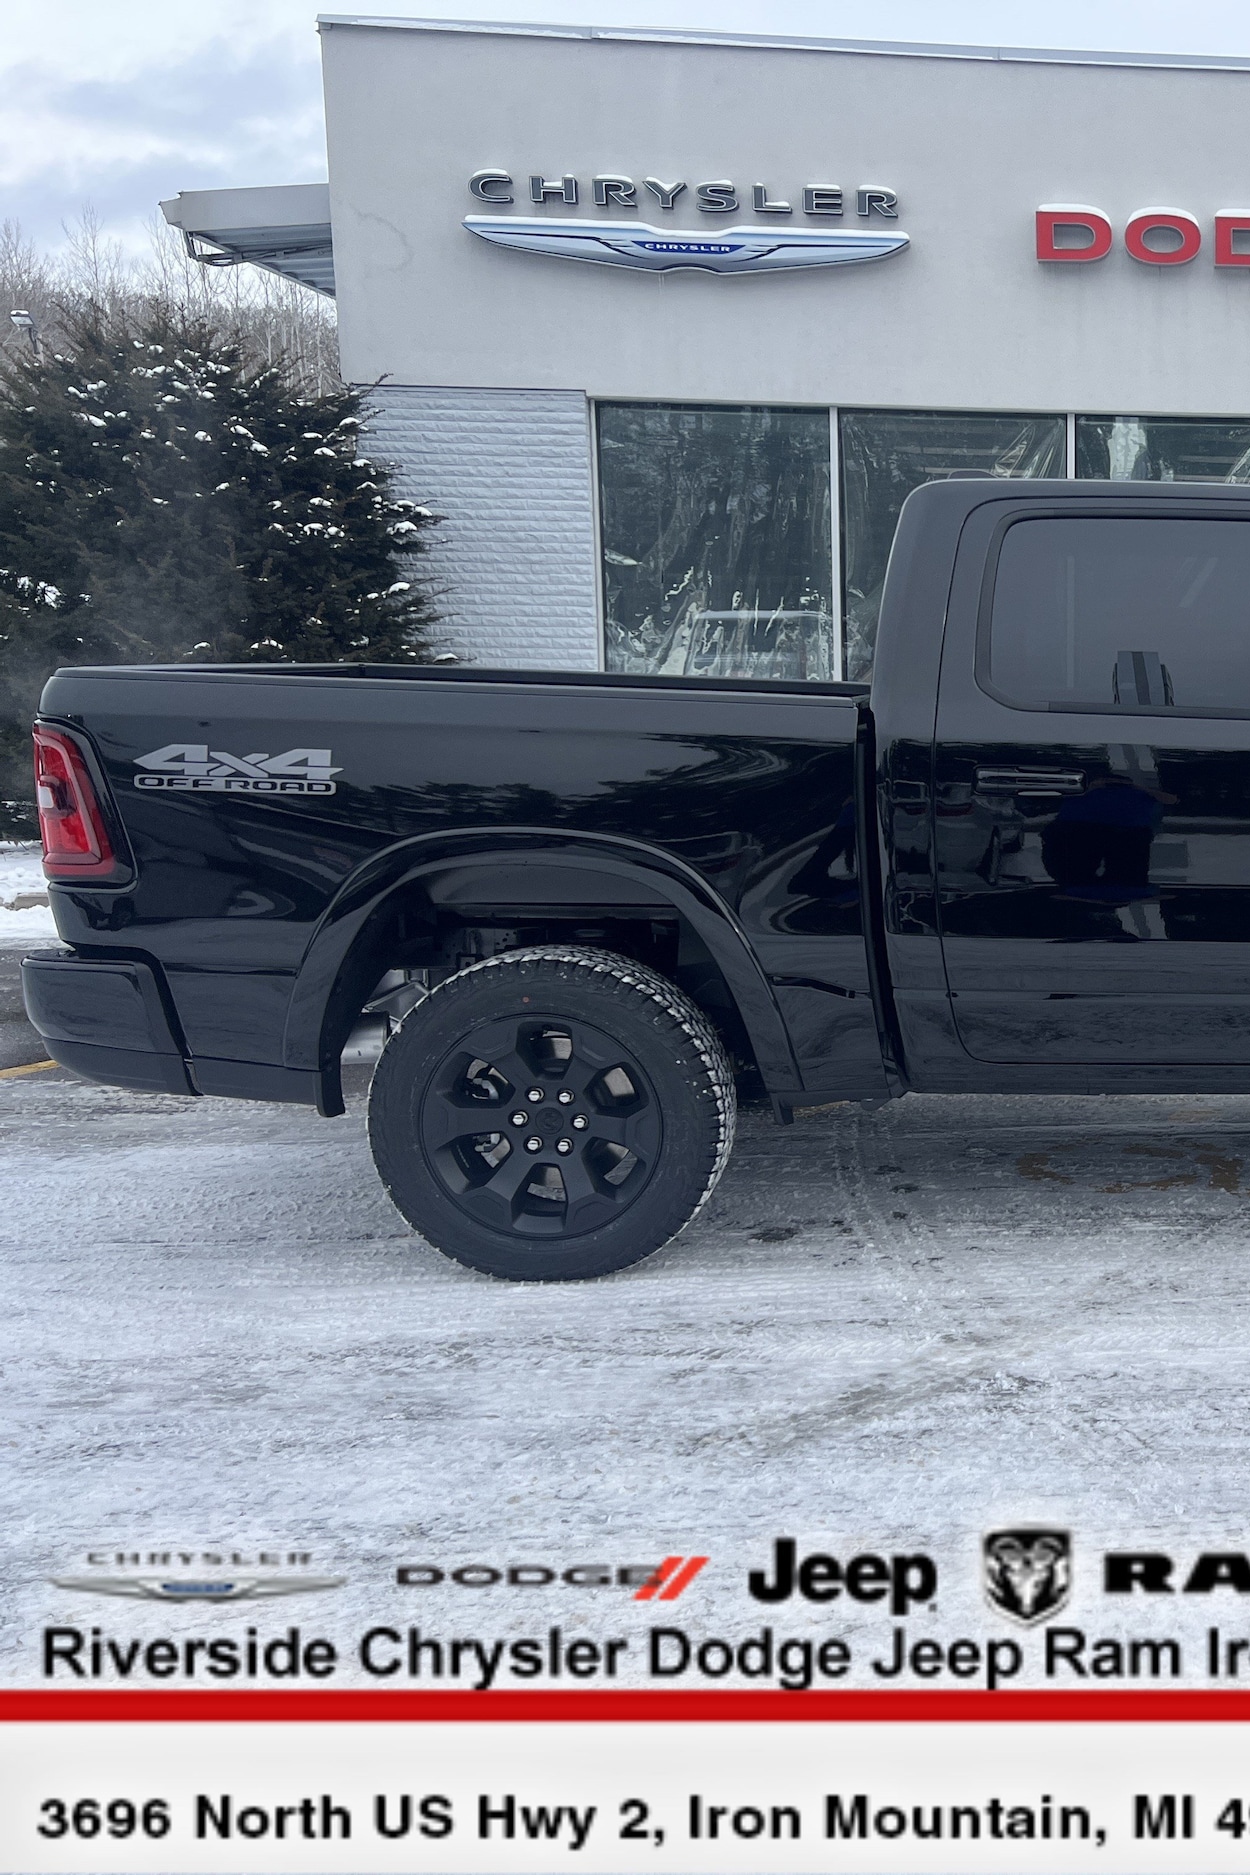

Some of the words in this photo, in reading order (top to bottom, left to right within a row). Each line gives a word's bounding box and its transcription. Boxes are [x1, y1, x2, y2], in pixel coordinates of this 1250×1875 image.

[467, 169, 898, 218] CHRYSLER
[644, 241, 732, 254] CHRYSLER
[138, 777, 215, 788] OFF
[224, 779, 332, 792] ROAD
